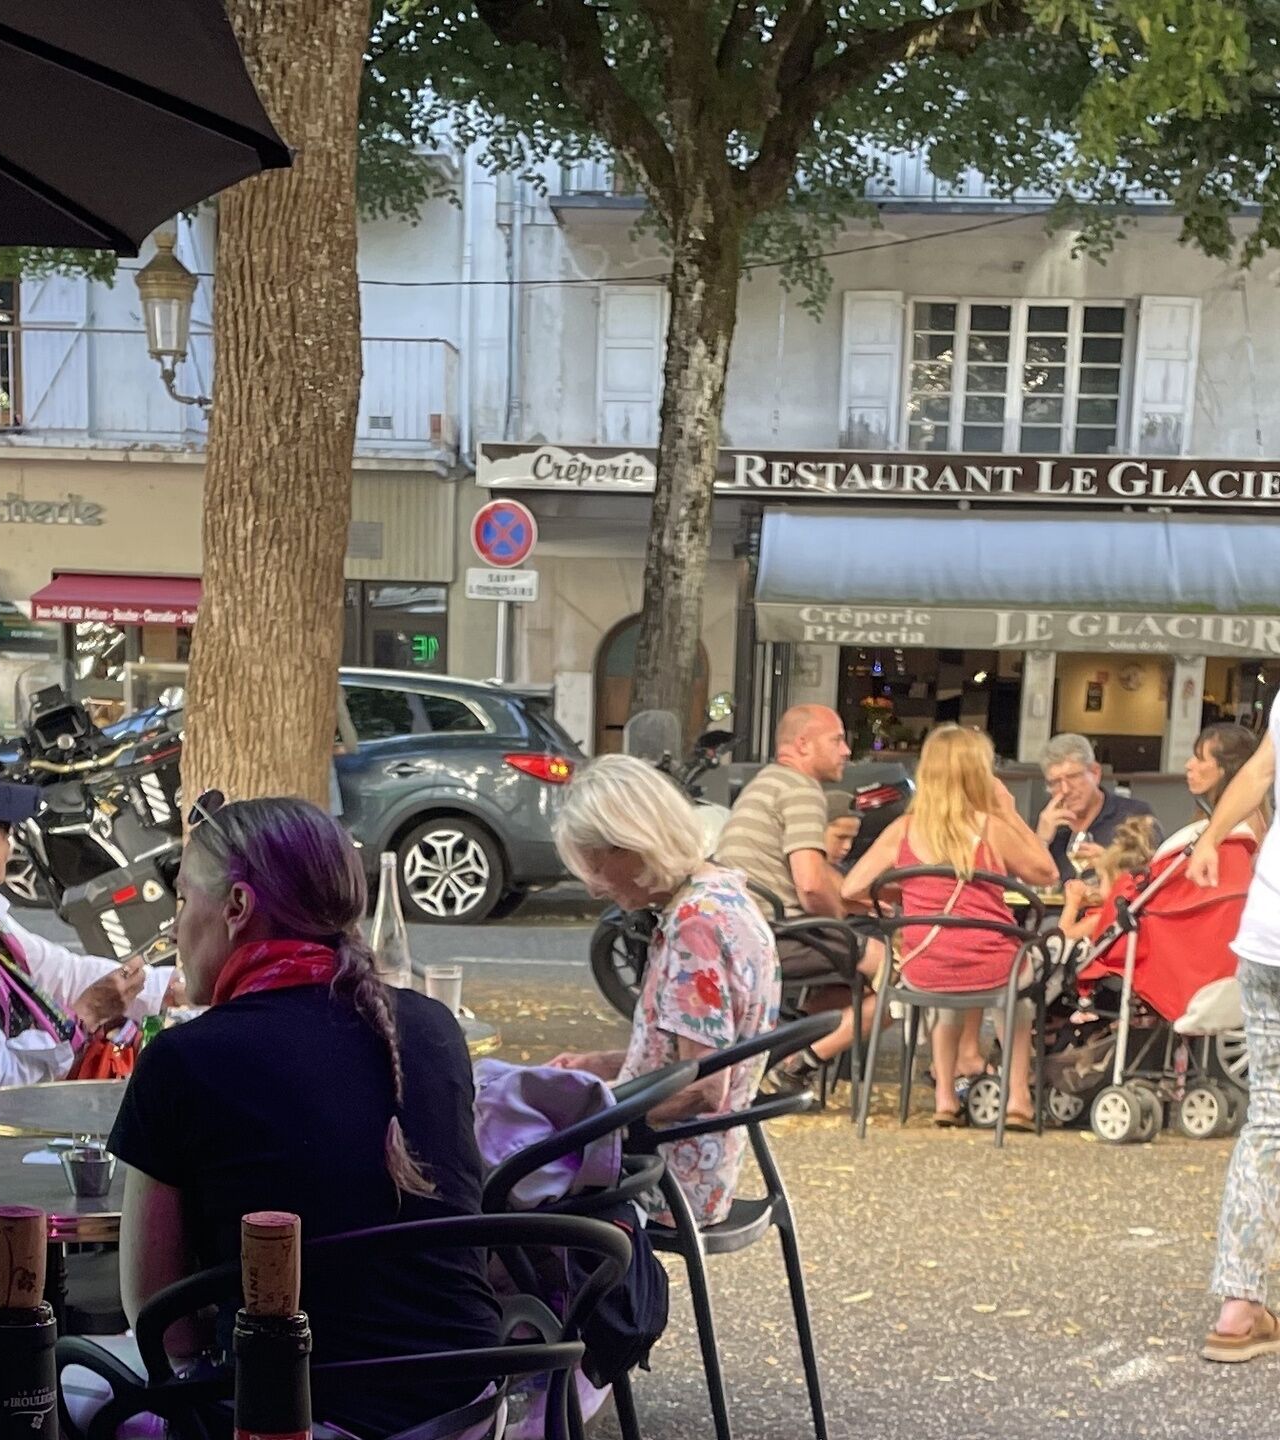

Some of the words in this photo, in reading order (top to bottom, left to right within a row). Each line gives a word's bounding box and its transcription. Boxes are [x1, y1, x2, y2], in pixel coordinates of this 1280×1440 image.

[532, 453, 645, 486] Crêperie
[732, 454, 1023, 493] RESTAURANT
[1035, 460, 1098, 495] LE
[798, 606, 932, 628] Crêperie
[992, 612, 1053, 647] LE
[802, 625, 927, 644] Pizzeria
